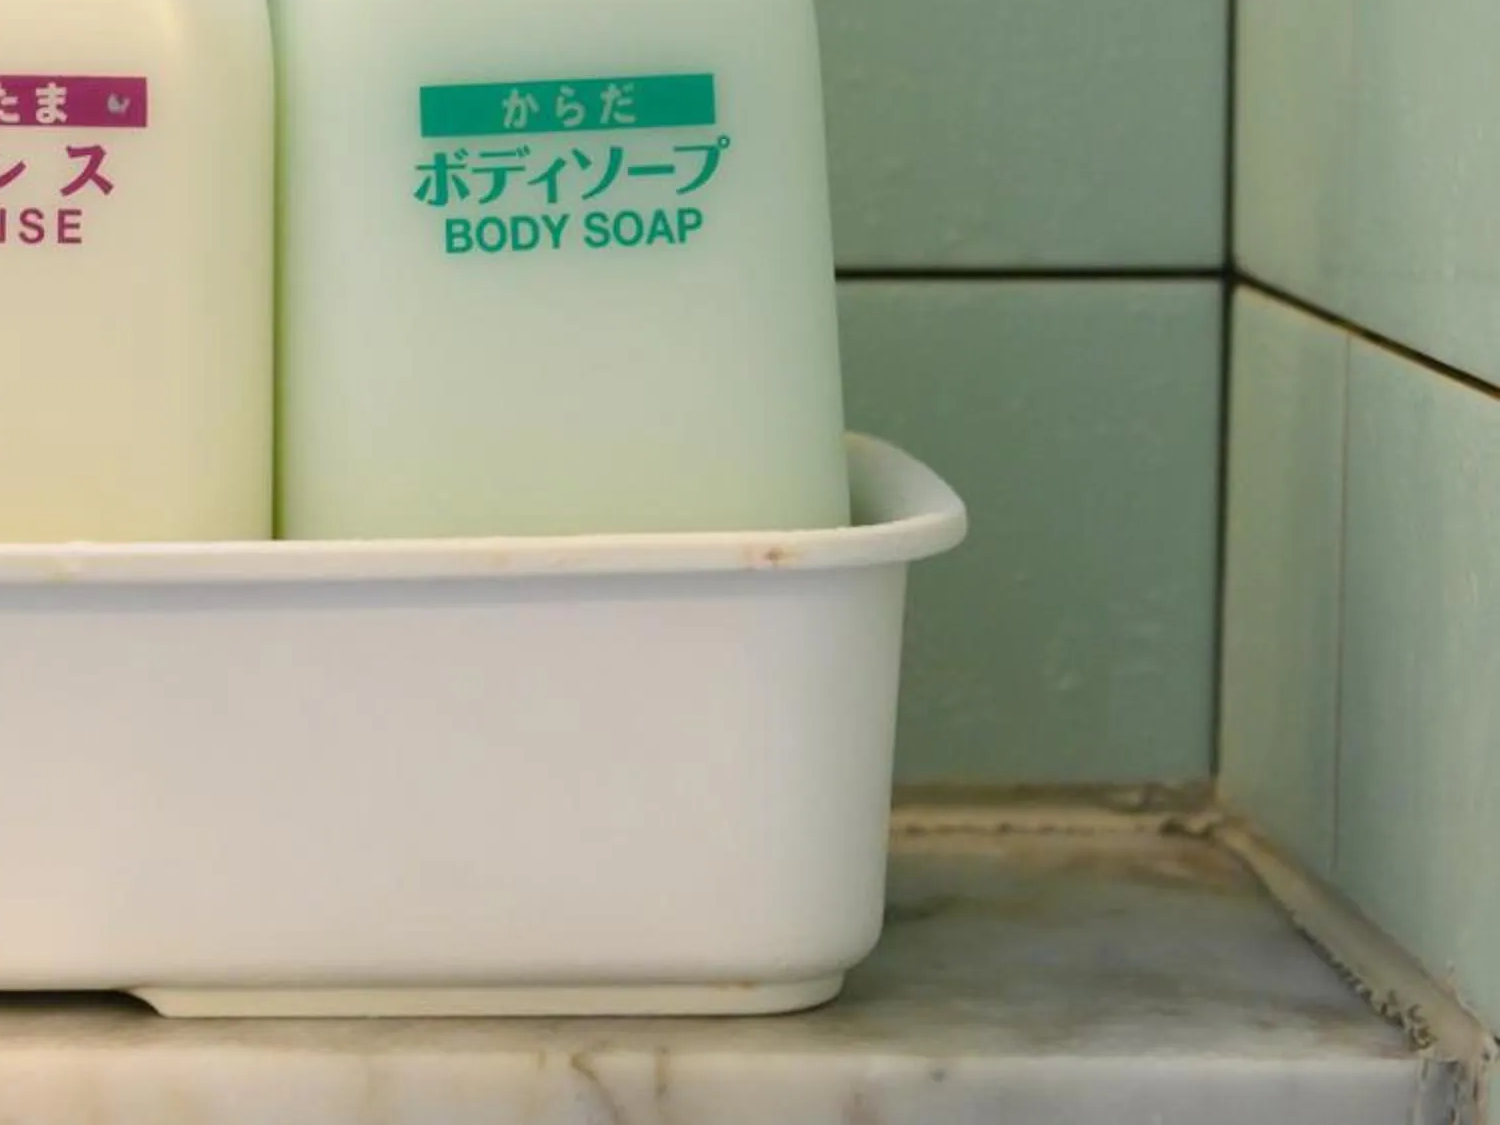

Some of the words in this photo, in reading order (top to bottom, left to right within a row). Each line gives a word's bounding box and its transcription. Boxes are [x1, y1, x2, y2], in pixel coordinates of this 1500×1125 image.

[501, 82, 637, 129] からだ
[413, 135, 730, 207] ボディソープ
[445, 213, 570, 254] BODY
[583, 207, 703, 249] SOAP
